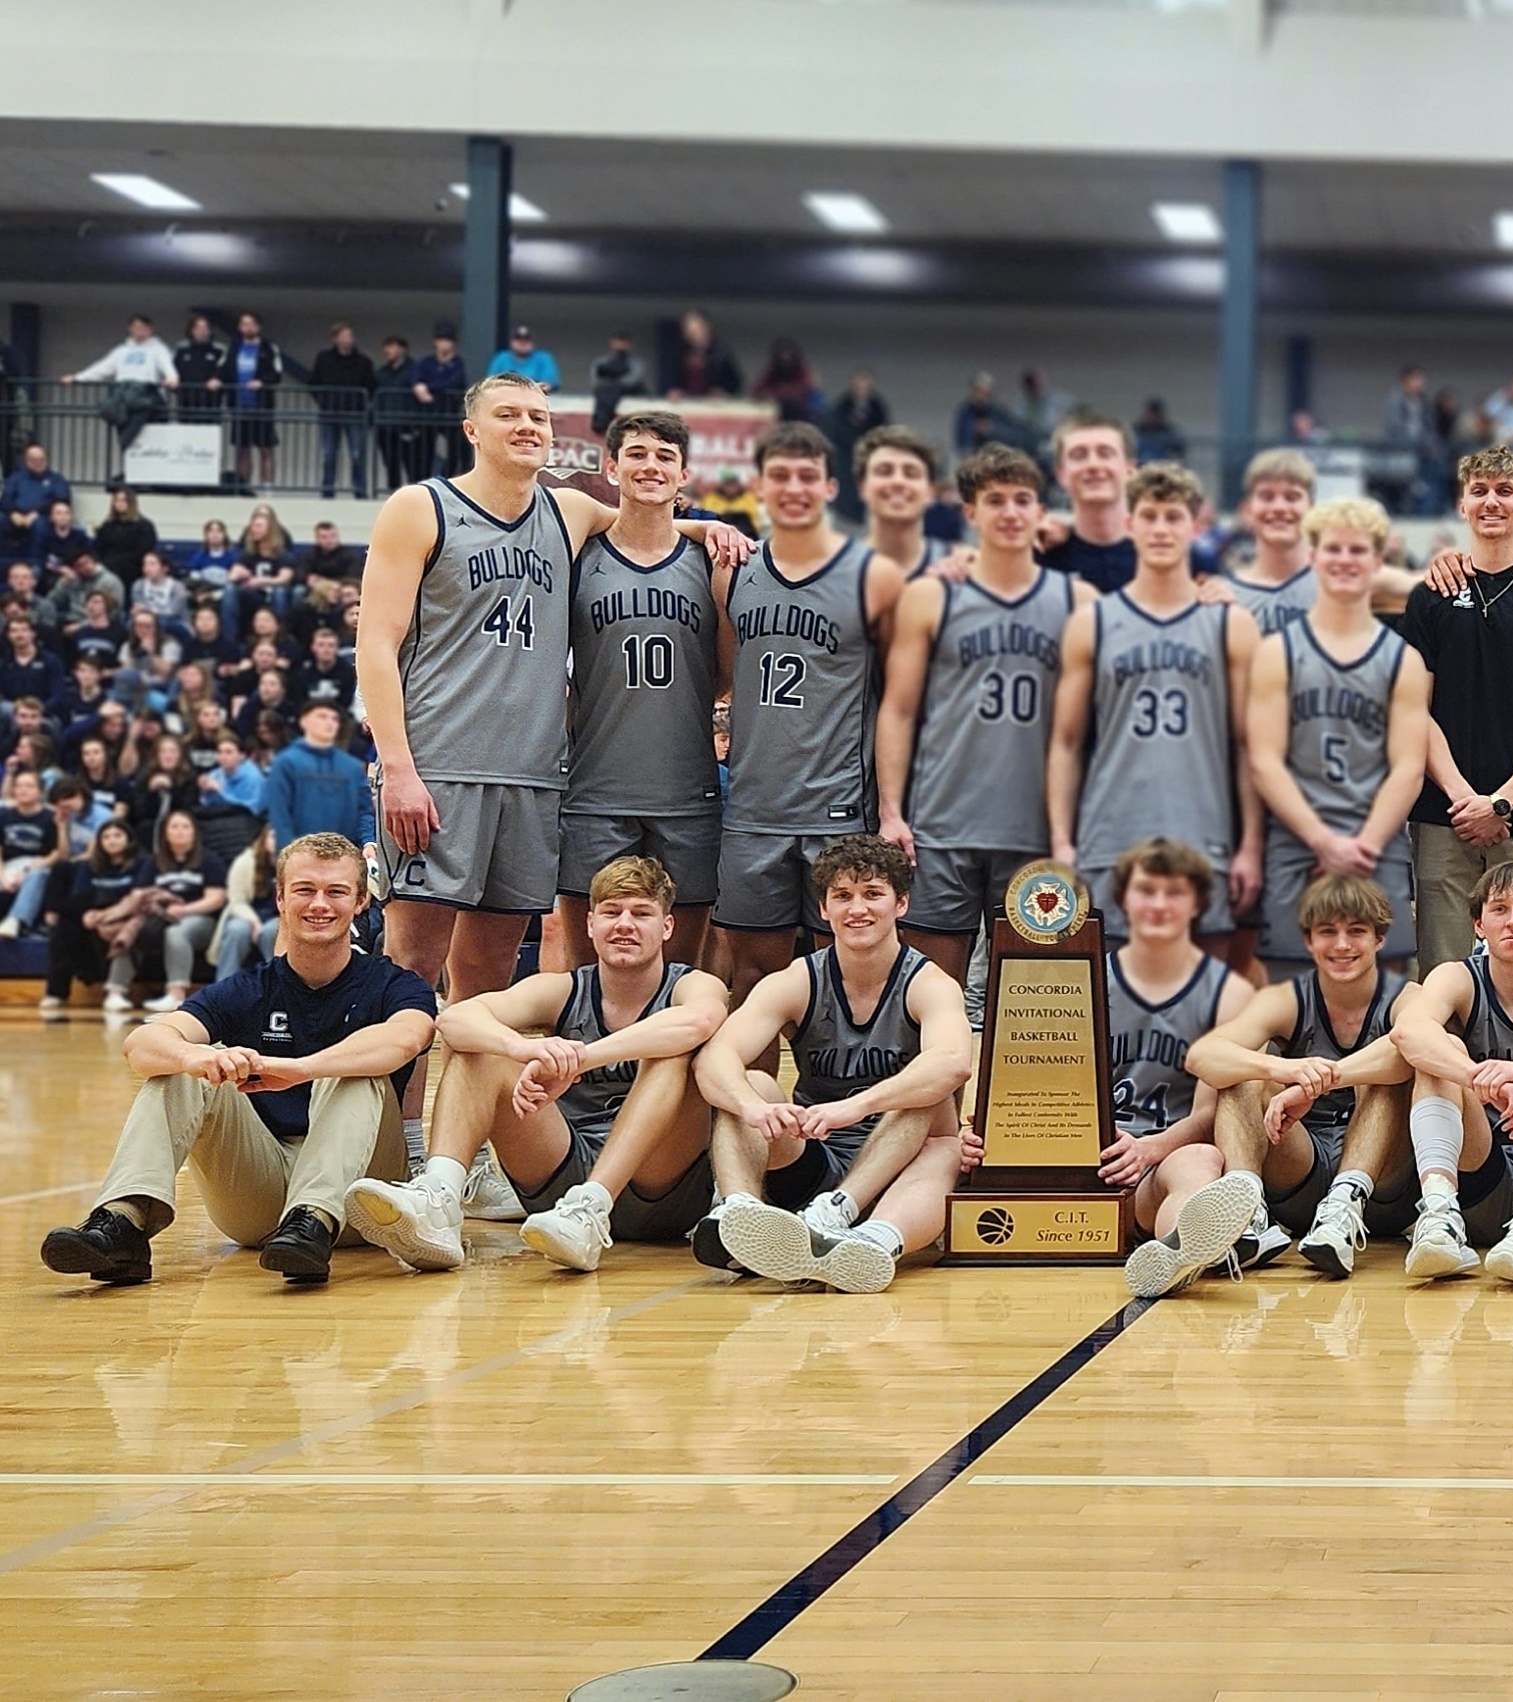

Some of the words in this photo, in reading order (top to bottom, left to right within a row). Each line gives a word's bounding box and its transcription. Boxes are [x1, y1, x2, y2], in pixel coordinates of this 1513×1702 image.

[545, 447, 597, 469] PAC
[467, 546, 553, 594] BULLDOGS
[481, 595, 535, 651] 44
[590, 587, 702, 635] BULLDOGS
[738, 604, 842, 655] BULLDOGS
[622, 634, 675, 689] 10
[958, 622, 1062, 671] BULLDOGS
[1112, 638, 1211, 687] BULLDOGS
[760, 651, 806, 709] 12
[976, 669, 1041, 725] 30
[1132, 686, 1192, 740] 33
[1321, 732, 1351, 787] 5
[405, 860, 426, 887] C
[1004, 1008, 1086, 1019] INVITATIONAL
[1008, 985, 1082, 995] CONCORDIA
[269, 1011, 288, 1032] C
[1010, 1031, 1079, 1042] BASKETBALL
[1003, 1054, 1086, 1065] TOURNAMENT
[1110, 1029, 1189, 1073] ULLDOG
[1112, 1077, 1171, 1128] 24
[1036, 1229, 1073, 1242] Since
[1078, 1230, 1110, 1242] 1951
[1054, 1211, 1089, 1224] C.I.T.
